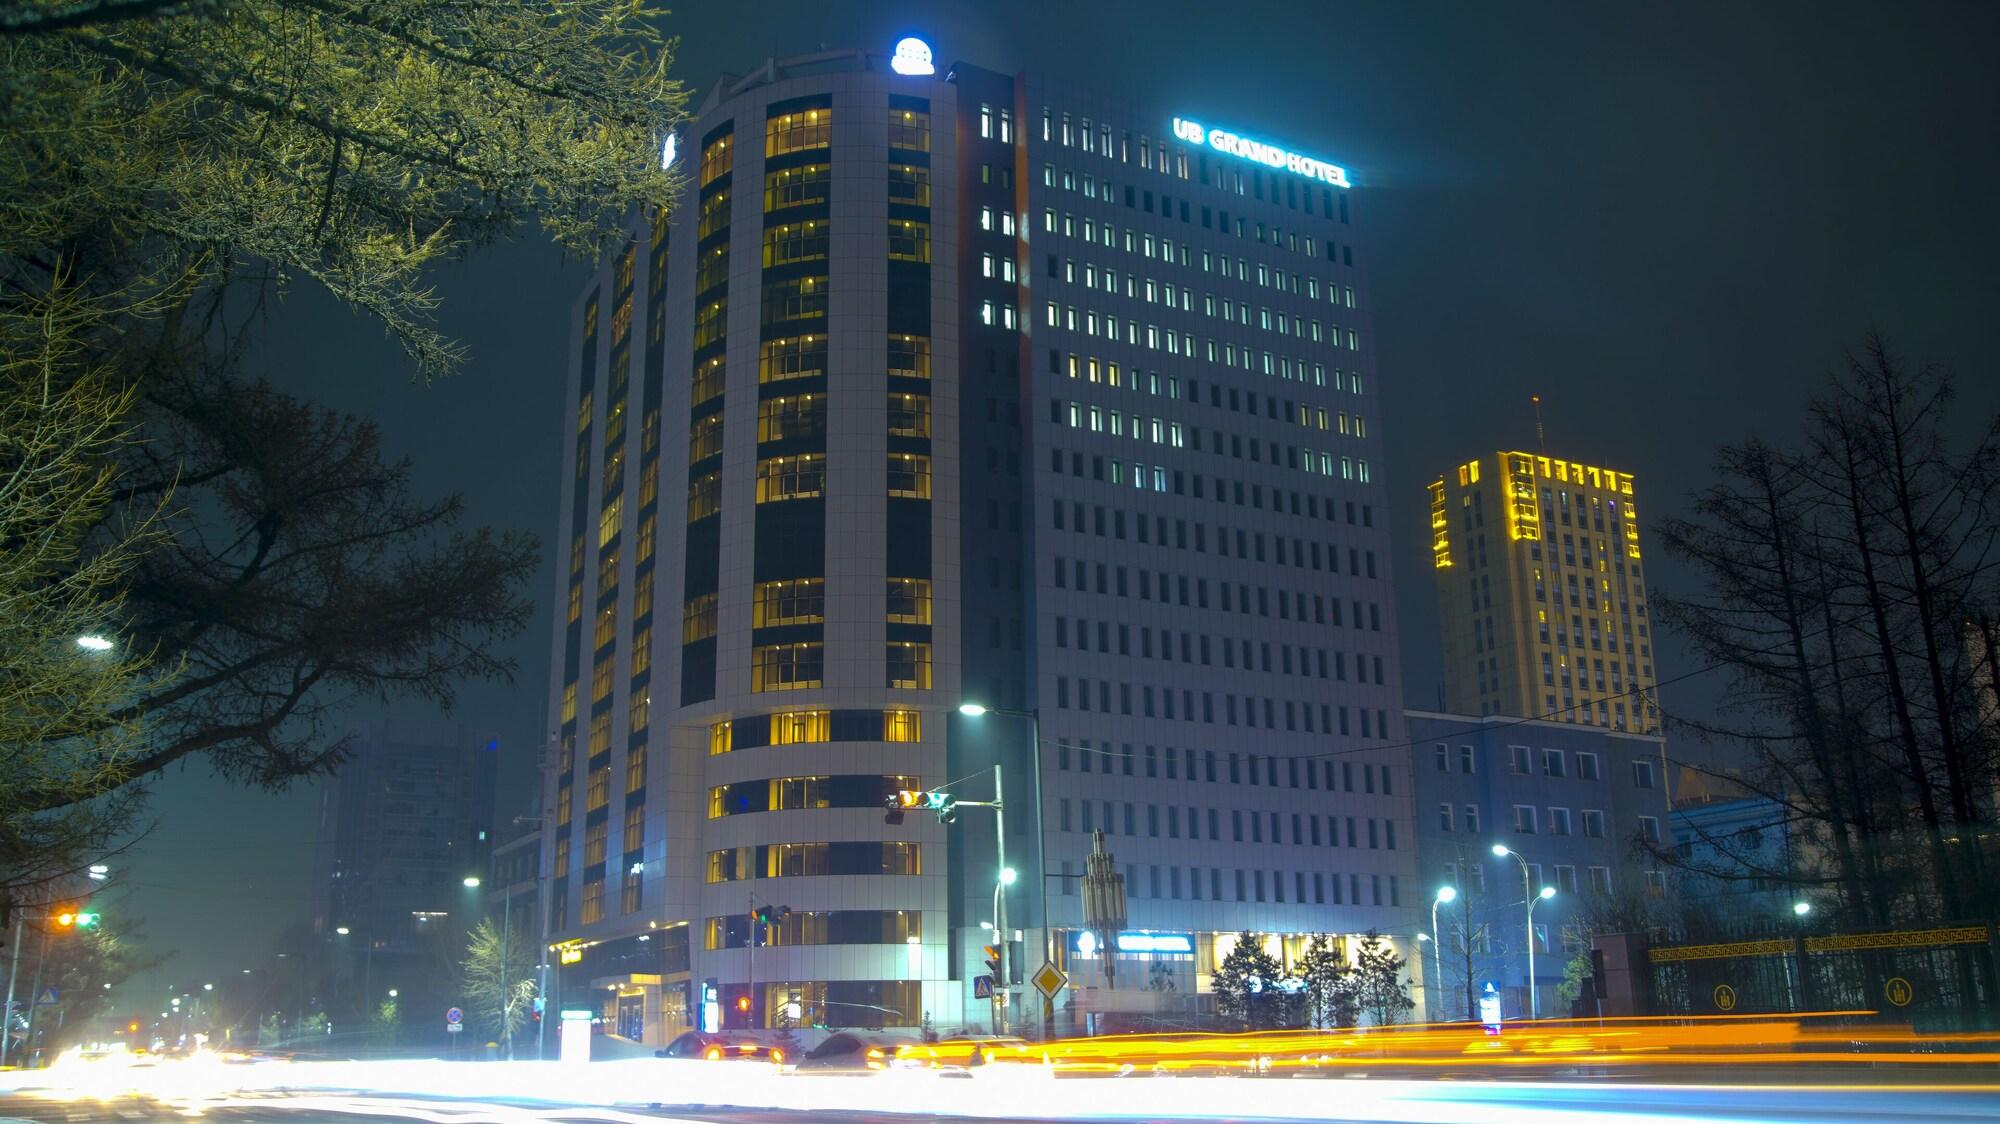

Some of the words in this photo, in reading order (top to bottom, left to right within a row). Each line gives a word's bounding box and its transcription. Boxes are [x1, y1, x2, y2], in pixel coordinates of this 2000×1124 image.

[1173, 117, 1204, 144] UB
[1209, 129, 1286, 168] GRAND
[1287, 152, 1351, 188] HOTEL
